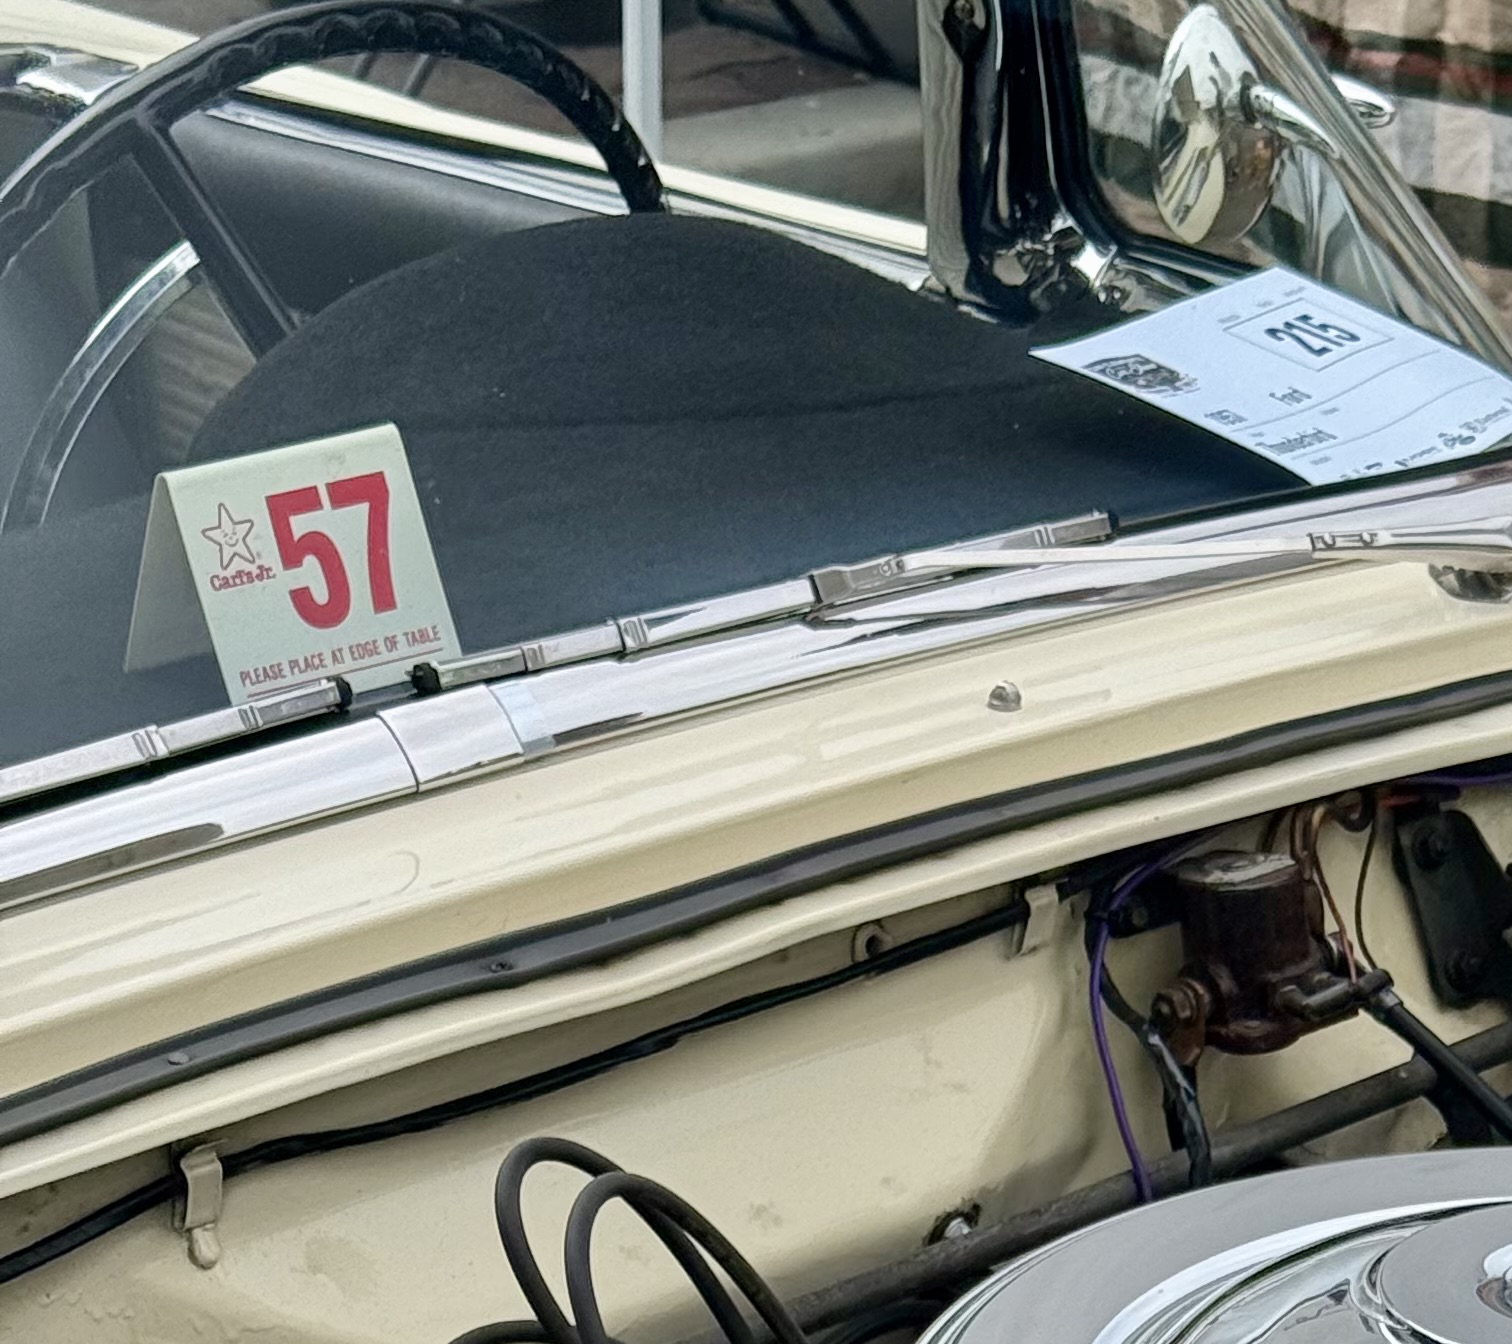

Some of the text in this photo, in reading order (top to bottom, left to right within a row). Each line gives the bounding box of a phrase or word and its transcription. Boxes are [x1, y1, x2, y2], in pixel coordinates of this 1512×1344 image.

[1264, 314, 1361, 358] 215
[265, 471, 398, 629] 57
[240, 625, 442, 688] PLEASE PLACE AT EDGE OF TABLE
